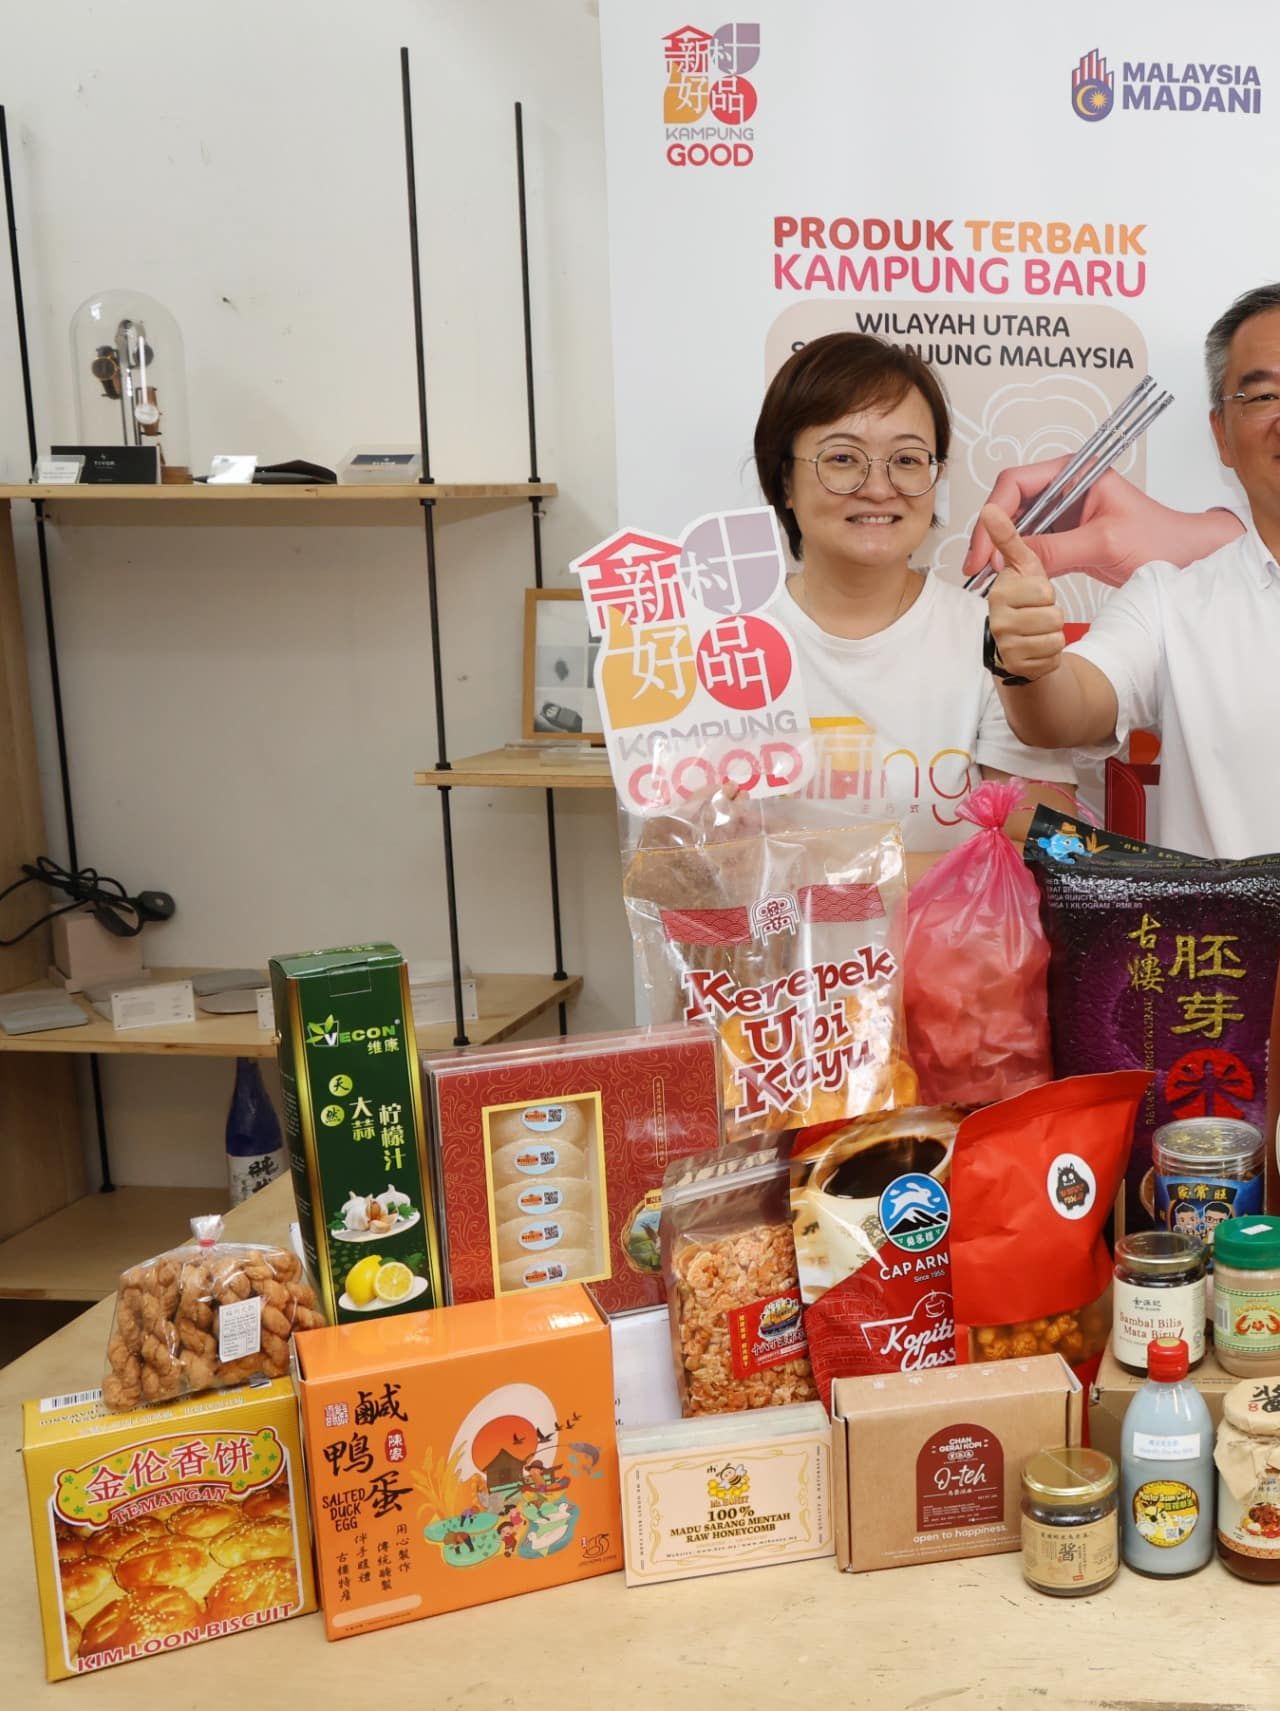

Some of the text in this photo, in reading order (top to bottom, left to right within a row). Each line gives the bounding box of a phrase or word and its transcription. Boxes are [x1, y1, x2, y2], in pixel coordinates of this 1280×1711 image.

[1122, 61, 1261, 87] MALAYSIA
[1122, 84, 1261, 114] MADANI
[666, 127, 754, 141] KAMPUNG
[666, 143, 753, 166] GOOD
[774, 216, 1147, 255] PRODUK TERBAIK
[773, 254, 1147, 297] KAMPUNG BARU
[855, 312, 1070, 337] WILAYAH UTARA
[999, 346, 1134, 369] MALAYSIA
[615, 710, 797, 761] KAMPUNG
[628, 741, 803, 809] GOOD
[683, 945, 898, 1021] Kerepek
[324, 1024, 397, 1047] VECON
[744, 1001, 848, 1062] Ubi
[734, 1039, 875, 1123] Kayu
[349, 1096, 376, 1141] 大蒜
[379, 1103, 406, 1171] 柠檬汁
[880, 1262, 913, 1280] CAP
[914, 1273, 929, 1282] Since
[1120, 1312, 1182, 1329] Sambal Bilis
[1124, 1325, 1176, 1339] Mata Biru
[949, 1436, 972, 1444] CHAN
[86, 1436, 254, 1505] 金伦香饼
[112, 1487, 227, 1524] TEMANGAN
[322, 1488, 365, 1509] SALTED
[330, 1503, 361, 1520] DUCK
[335, 1518, 358, 1532] EGG
[670, 1512, 791, 1536] MADU SARANG MENTAH
[686, 1523, 776, 1543] RAW HONEYCOMB
[913, 1523, 1008, 1545] open to happiness.
[77, 1603, 293, 1672] KIM LOON BISCUIT
